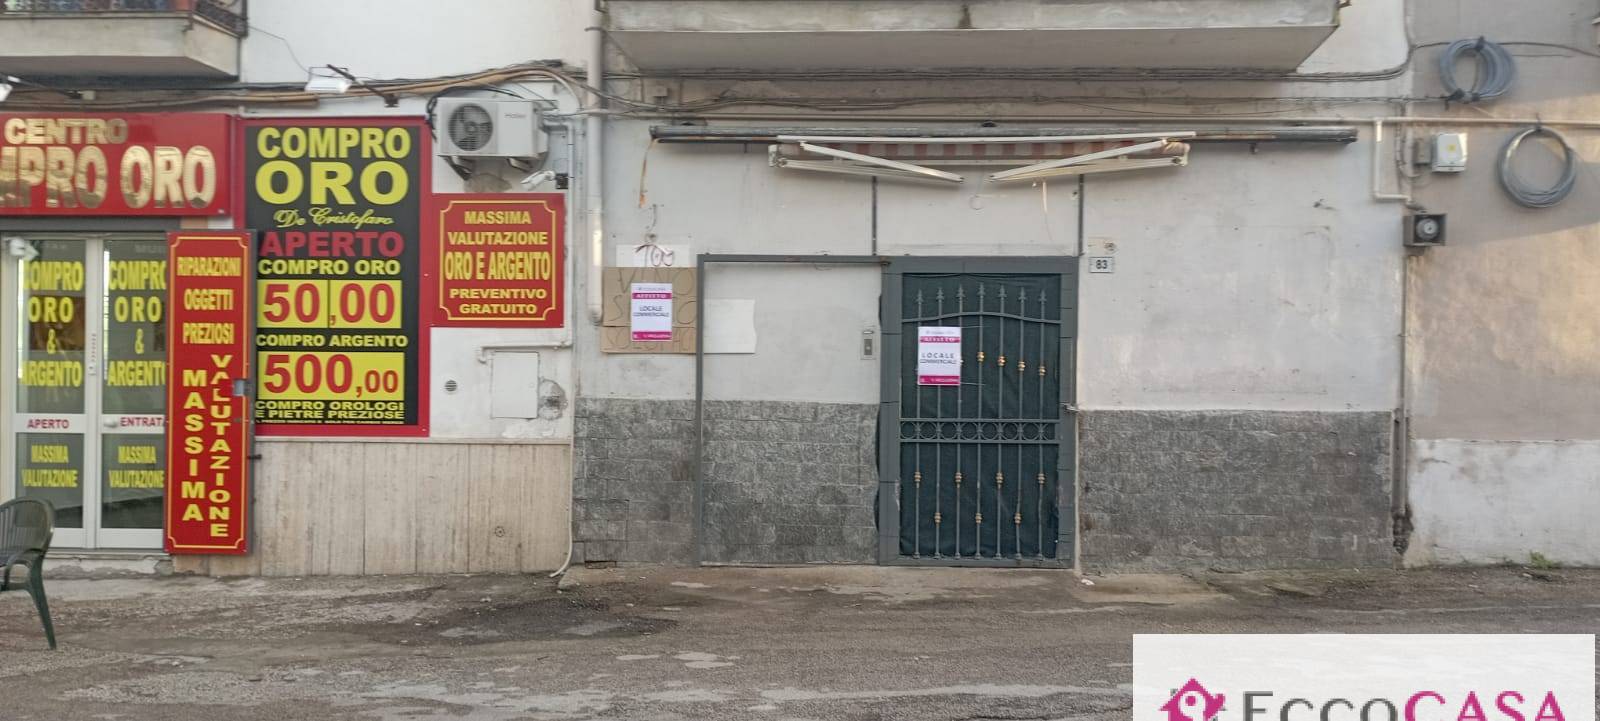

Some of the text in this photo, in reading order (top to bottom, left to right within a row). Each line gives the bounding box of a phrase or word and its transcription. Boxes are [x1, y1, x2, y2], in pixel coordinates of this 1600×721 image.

[4, 118, 128, 144] CENTRO
[257, 127, 411, 159] COMPRO
[120, 145, 216, 208] ORO
[255, 160, 409, 205] ORO
[273, 207, 395, 229] De Cristofaro
[464, 211, 532, 225] MASSIMA
[259, 231, 405, 257] APERTO
[447, 231, 549, 245] VALUTAZIONE
[177, 256, 241, 277] RIPARAZIONI
[258, 259, 401, 275] COMPRO ORO
[445, 251, 551, 280] ORO E ARGENTO
[1096, 260, 1107, 269] 83
[184, 288, 233, 310] OGGETTI
[263, 283, 395, 325] 50,00
[449, 288, 547, 299] PREVENTIVO
[28, 296, 73, 322] ORO
[114, 296, 162, 322] ORO
[460, 304, 537, 314] GRATUITO
[47, 328, 56, 354] &
[134, 328, 144, 354] &
[182, 322, 234, 344] PREZIOSI
[256, 334, 409, 348] COMPRO ARGENTO
[264, 353, 399, 398] 500,00
[255, 401, 404, 411] COMPRO OROLOGI
[255, 410, 405, 419] E PIETRE PREZIOSE
[27, 419, 69, 429] APERTO
[31, 444, 69, 463] MASSIMA
[118, 446, 156, 464] MASSIMA
[182, 369, 207, 521] MASSIMA
[208, 354, 232, 537] VALUTAZIONE
[22, 468, 78, 488] VALUTAZIONE
[108, 470, 165, 488] VALUTAZIONE
